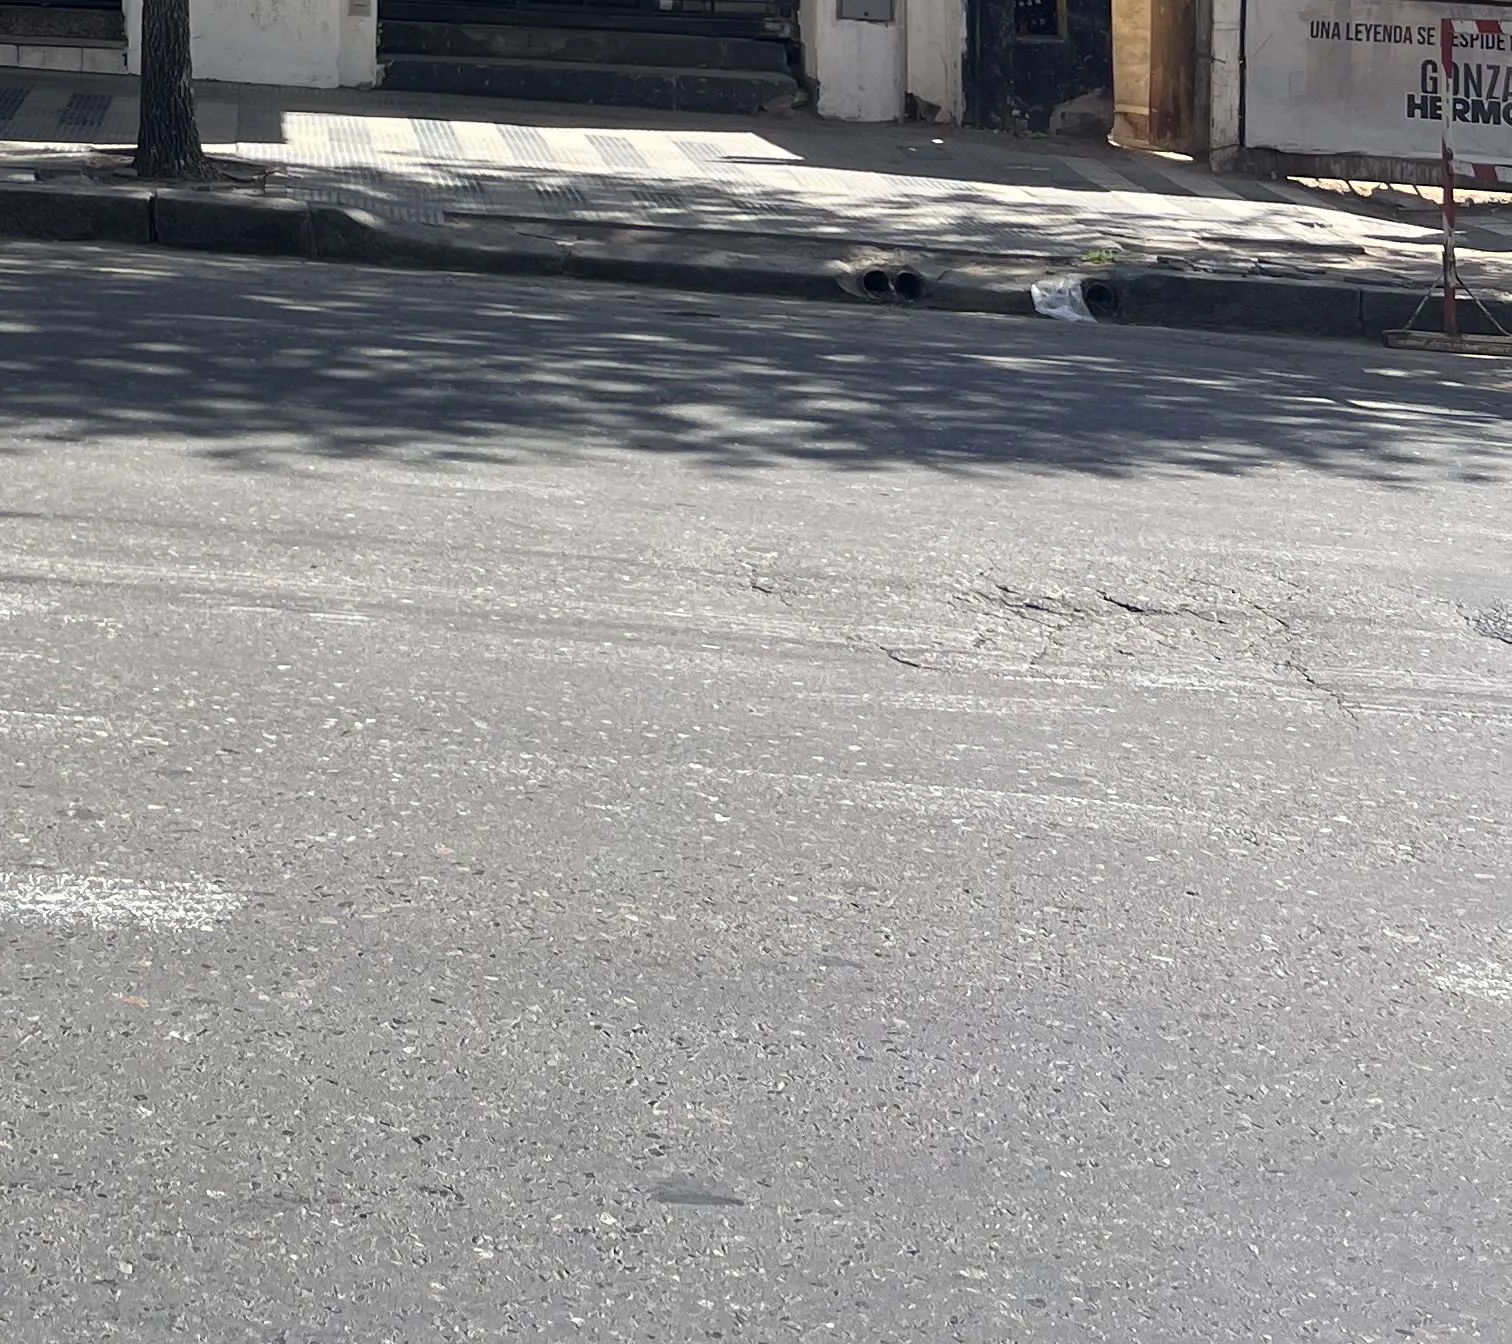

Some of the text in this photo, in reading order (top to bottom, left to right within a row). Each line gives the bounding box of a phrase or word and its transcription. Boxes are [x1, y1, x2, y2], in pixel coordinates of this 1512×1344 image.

[1310, 20, 1340, 40] UNA
[1345, 22, 1413, 44] LEYENDA
[1417, 26, 1436, 45] SE
[1441, 29, 1505, 51] ESPIDE
